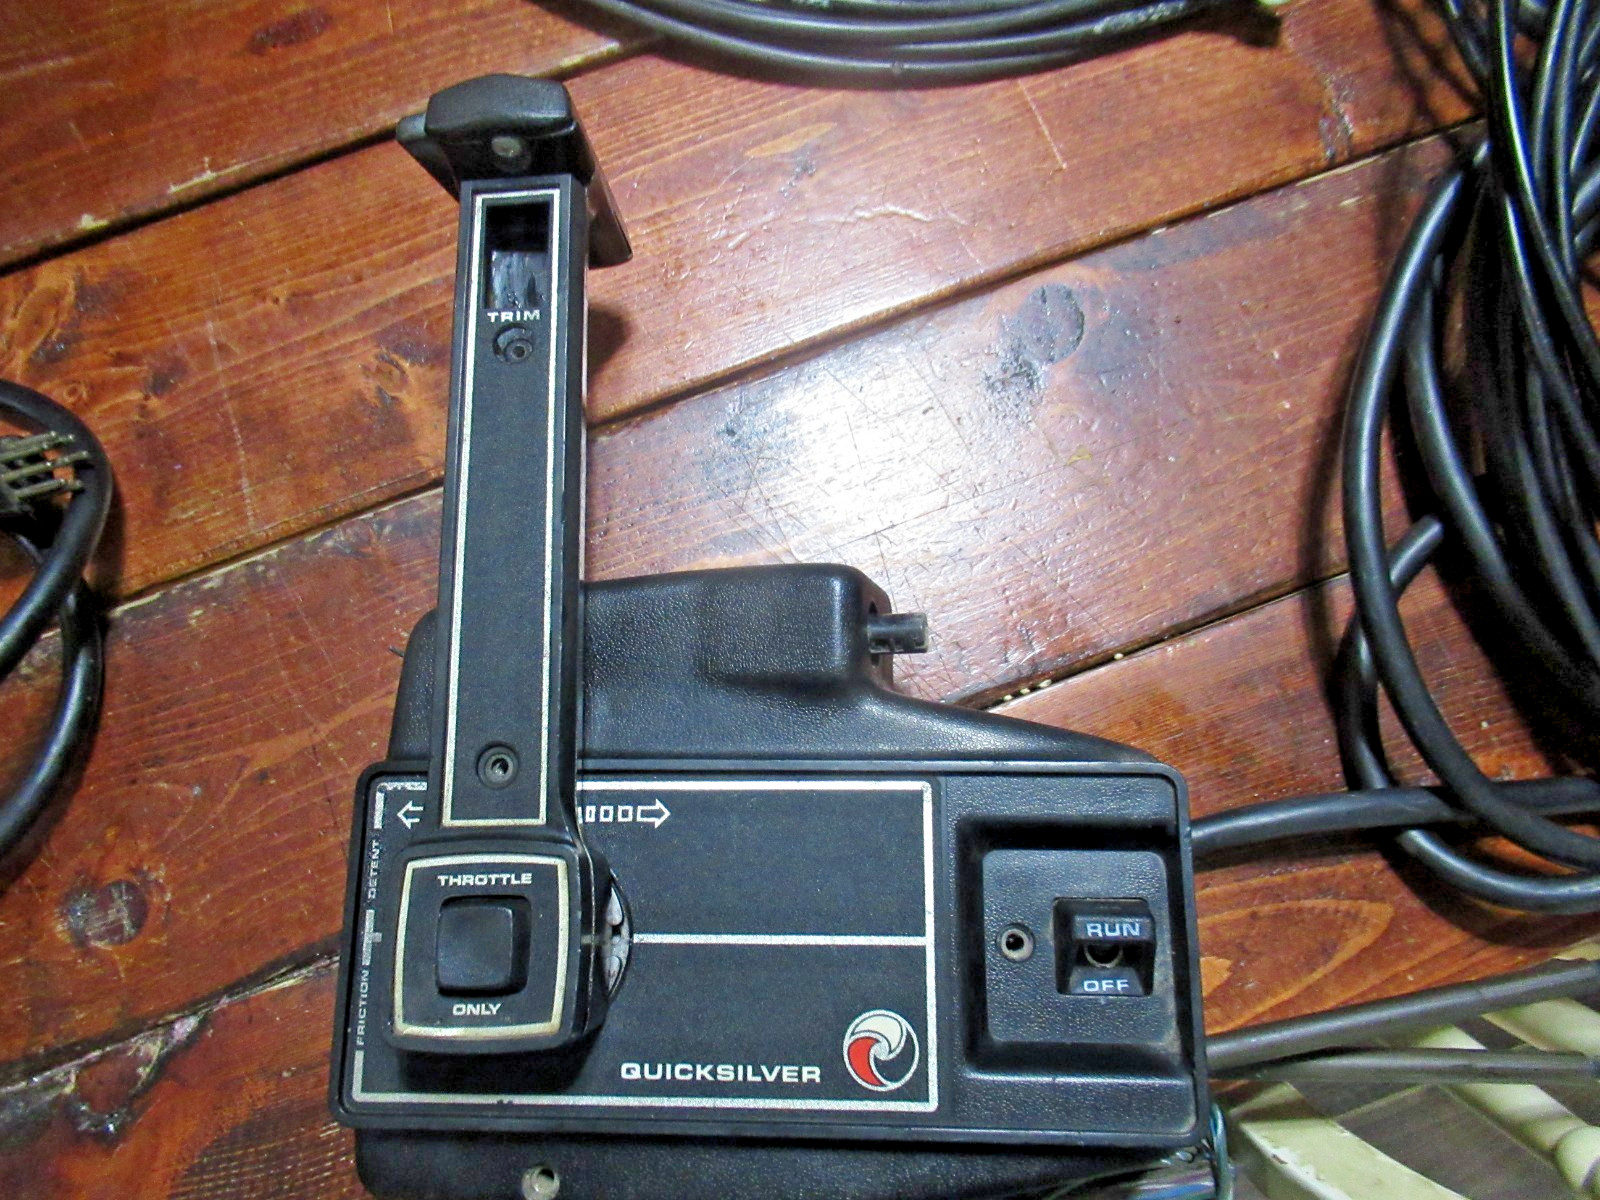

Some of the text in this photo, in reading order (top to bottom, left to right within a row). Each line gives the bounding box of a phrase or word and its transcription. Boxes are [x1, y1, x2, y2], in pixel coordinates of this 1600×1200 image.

[487, 309, 541, 323] TRIM
[367, 840, 381, 900] DETENT
[437, 872, 533, 886] THROTTLE
[1086, 922, 1141, 938] RUN
[1083, 979, 1130, 993] OFF
[356, 969, 370, 1046] FRICTION
[452, 1002, 502, 1016] ONLY
[620, 1062, 822, 1084] QUICKSILVER
